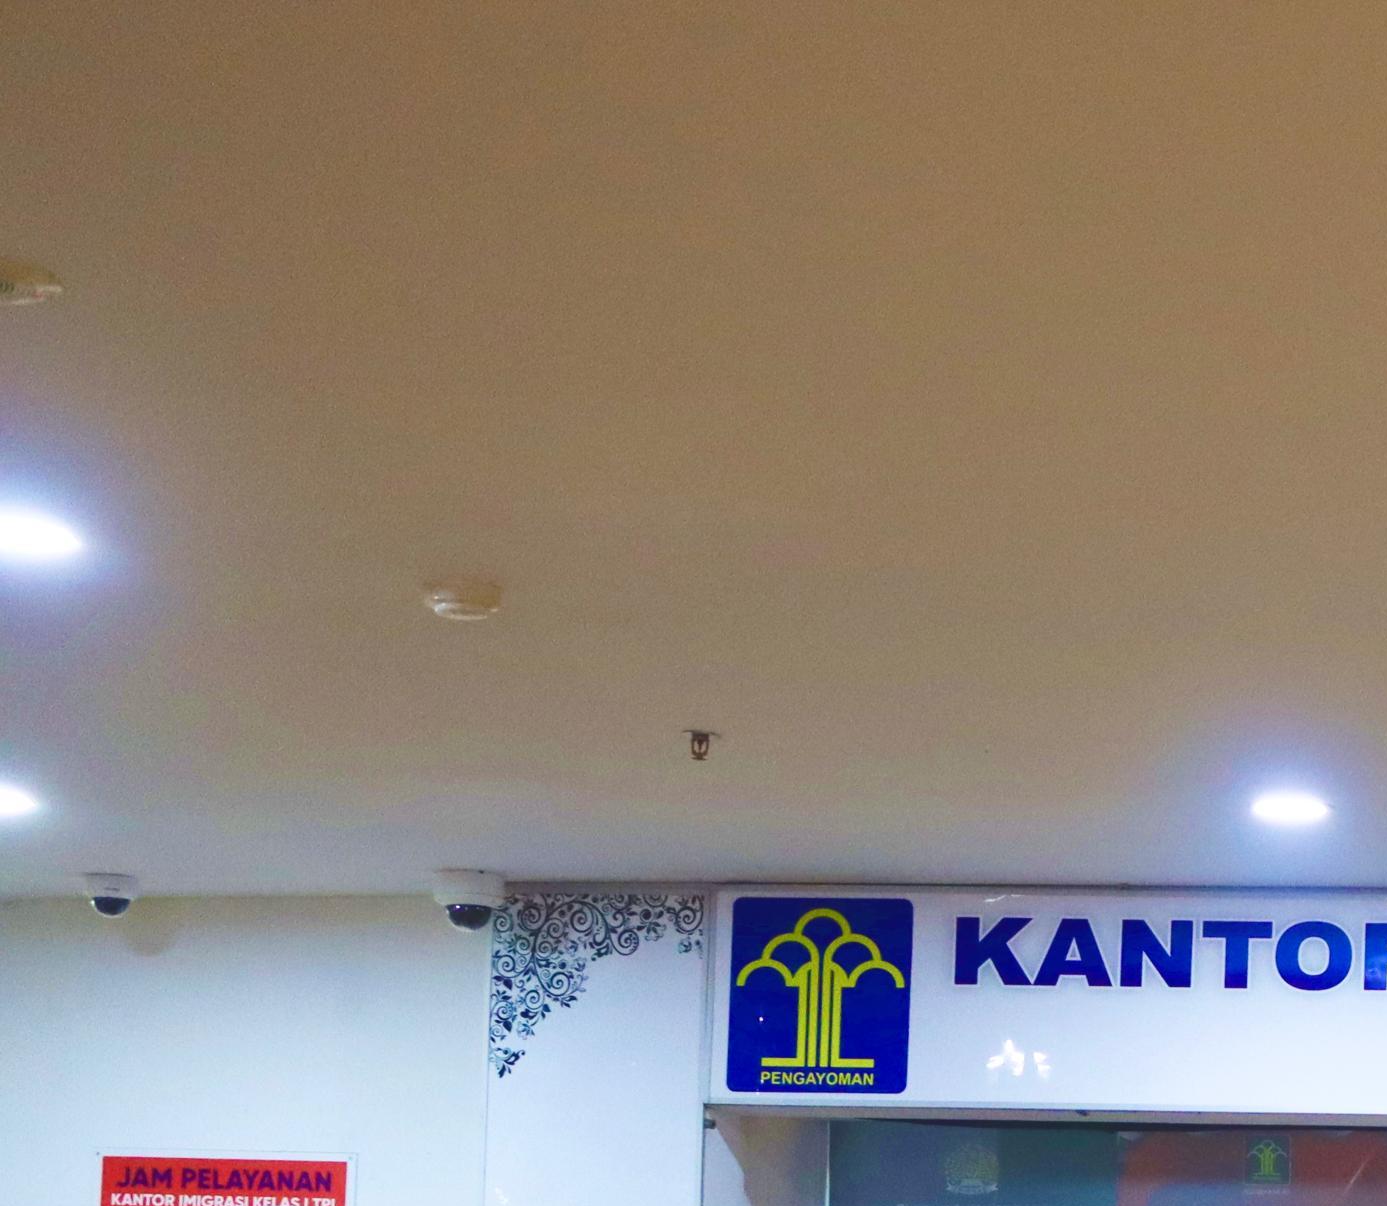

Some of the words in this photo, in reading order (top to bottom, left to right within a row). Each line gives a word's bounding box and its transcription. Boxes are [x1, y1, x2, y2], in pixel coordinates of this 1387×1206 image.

[760, 1070, 874, 1087] PENGAYOMAN
[116, 1167, 173, 1189] JAM
[181, 1168, 333, 1192] PELAYANAN
